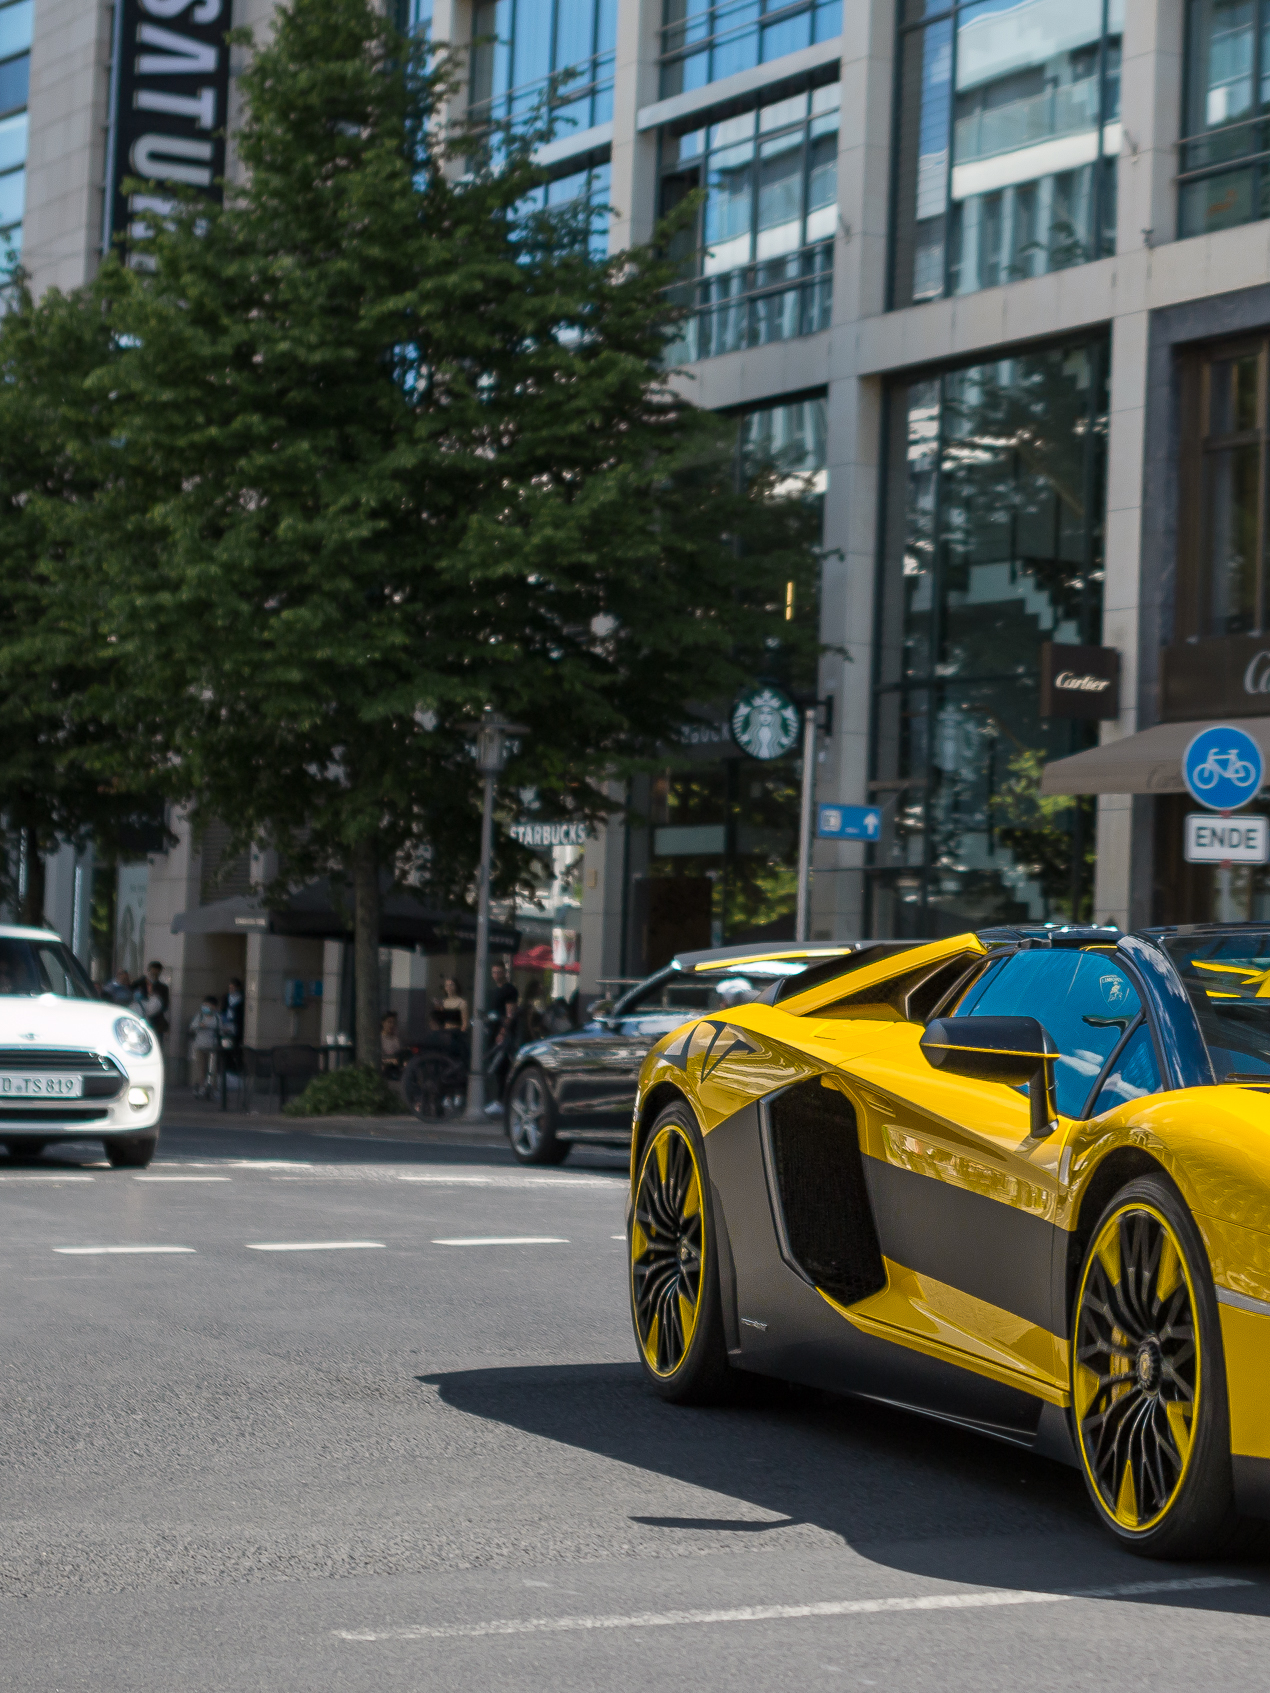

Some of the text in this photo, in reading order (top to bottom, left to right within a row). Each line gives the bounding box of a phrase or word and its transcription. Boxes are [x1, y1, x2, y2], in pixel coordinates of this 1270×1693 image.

[1055, 671, 1110, 691] Cartier
[510, 824, 586, 845] STARBUCKS
[1196, 826, 1258, 849] ENDE
